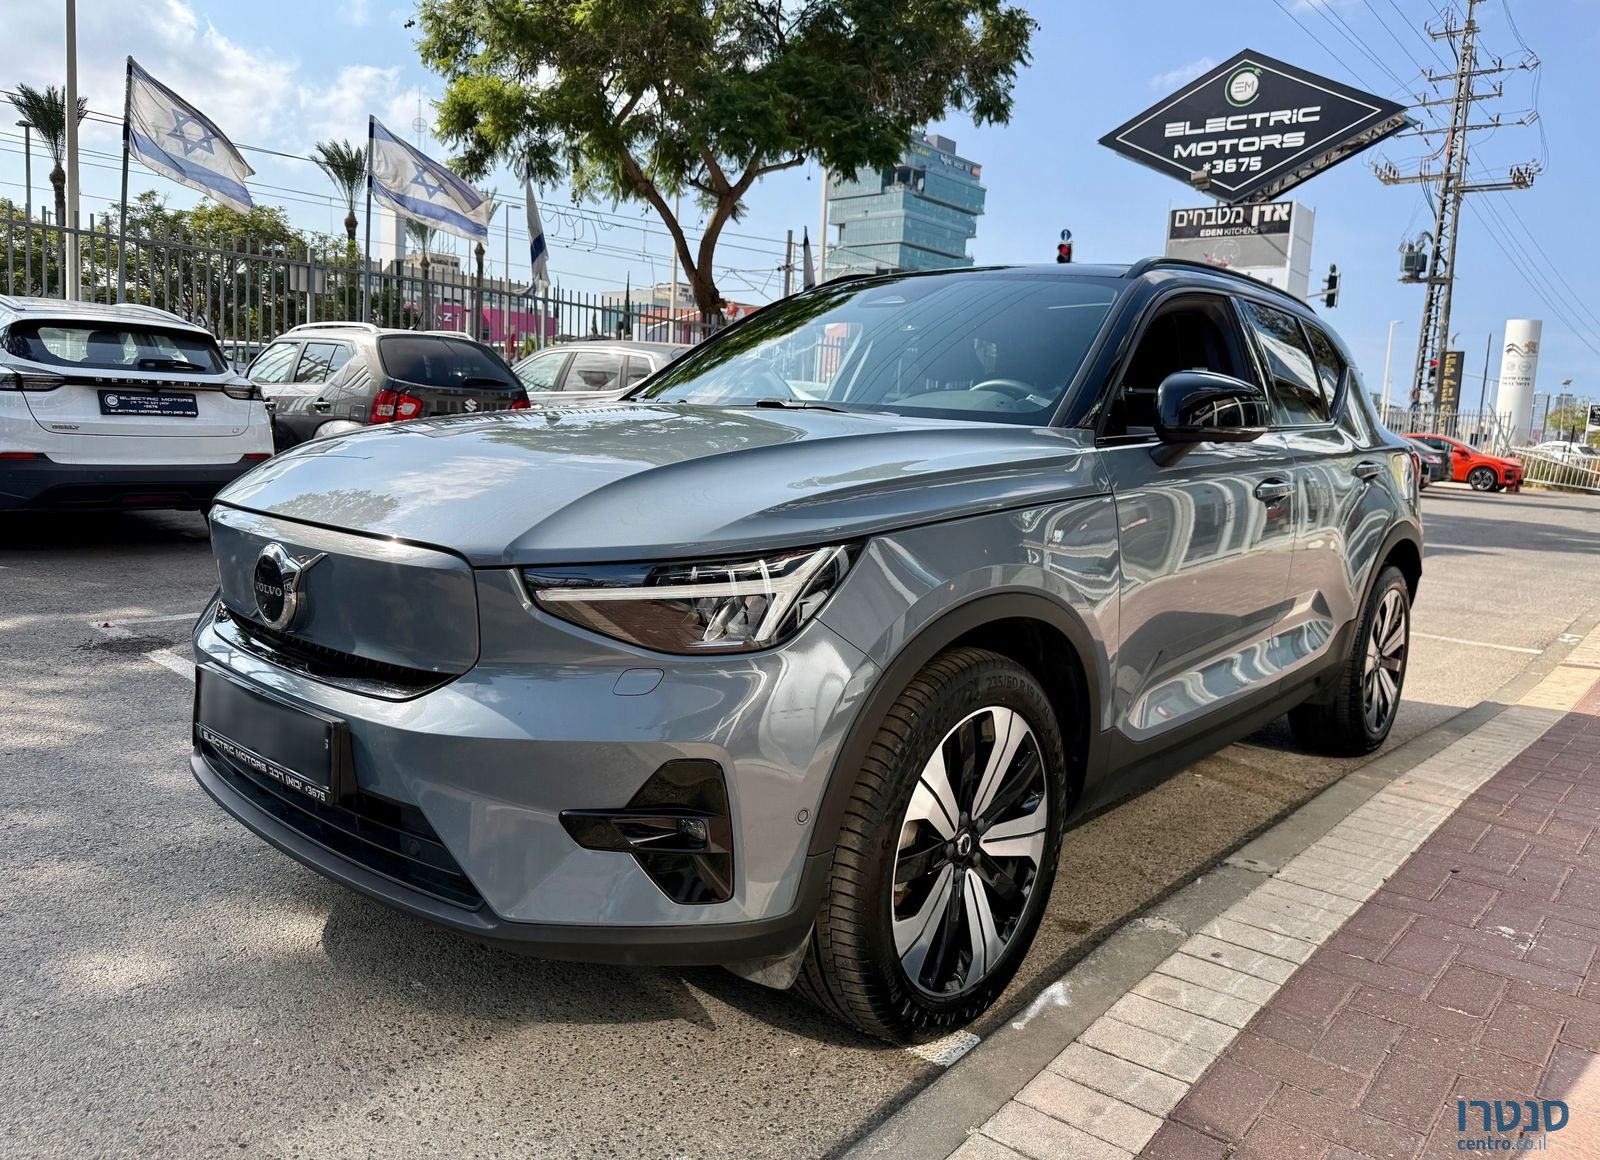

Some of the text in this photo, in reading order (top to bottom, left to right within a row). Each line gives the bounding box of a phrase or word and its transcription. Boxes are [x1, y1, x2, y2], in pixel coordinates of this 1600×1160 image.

[1173, 131, 1306, 158] MOTORS
[1174, 203, 1291, 228] אדן מטבחים
[1200, 228, 1223, 237] EDEN
[95, 377, 202, 386] GEOMETRY
[256, 581, 283, 597] VOLVO
[235, 749, 267, 773] MOTORS
